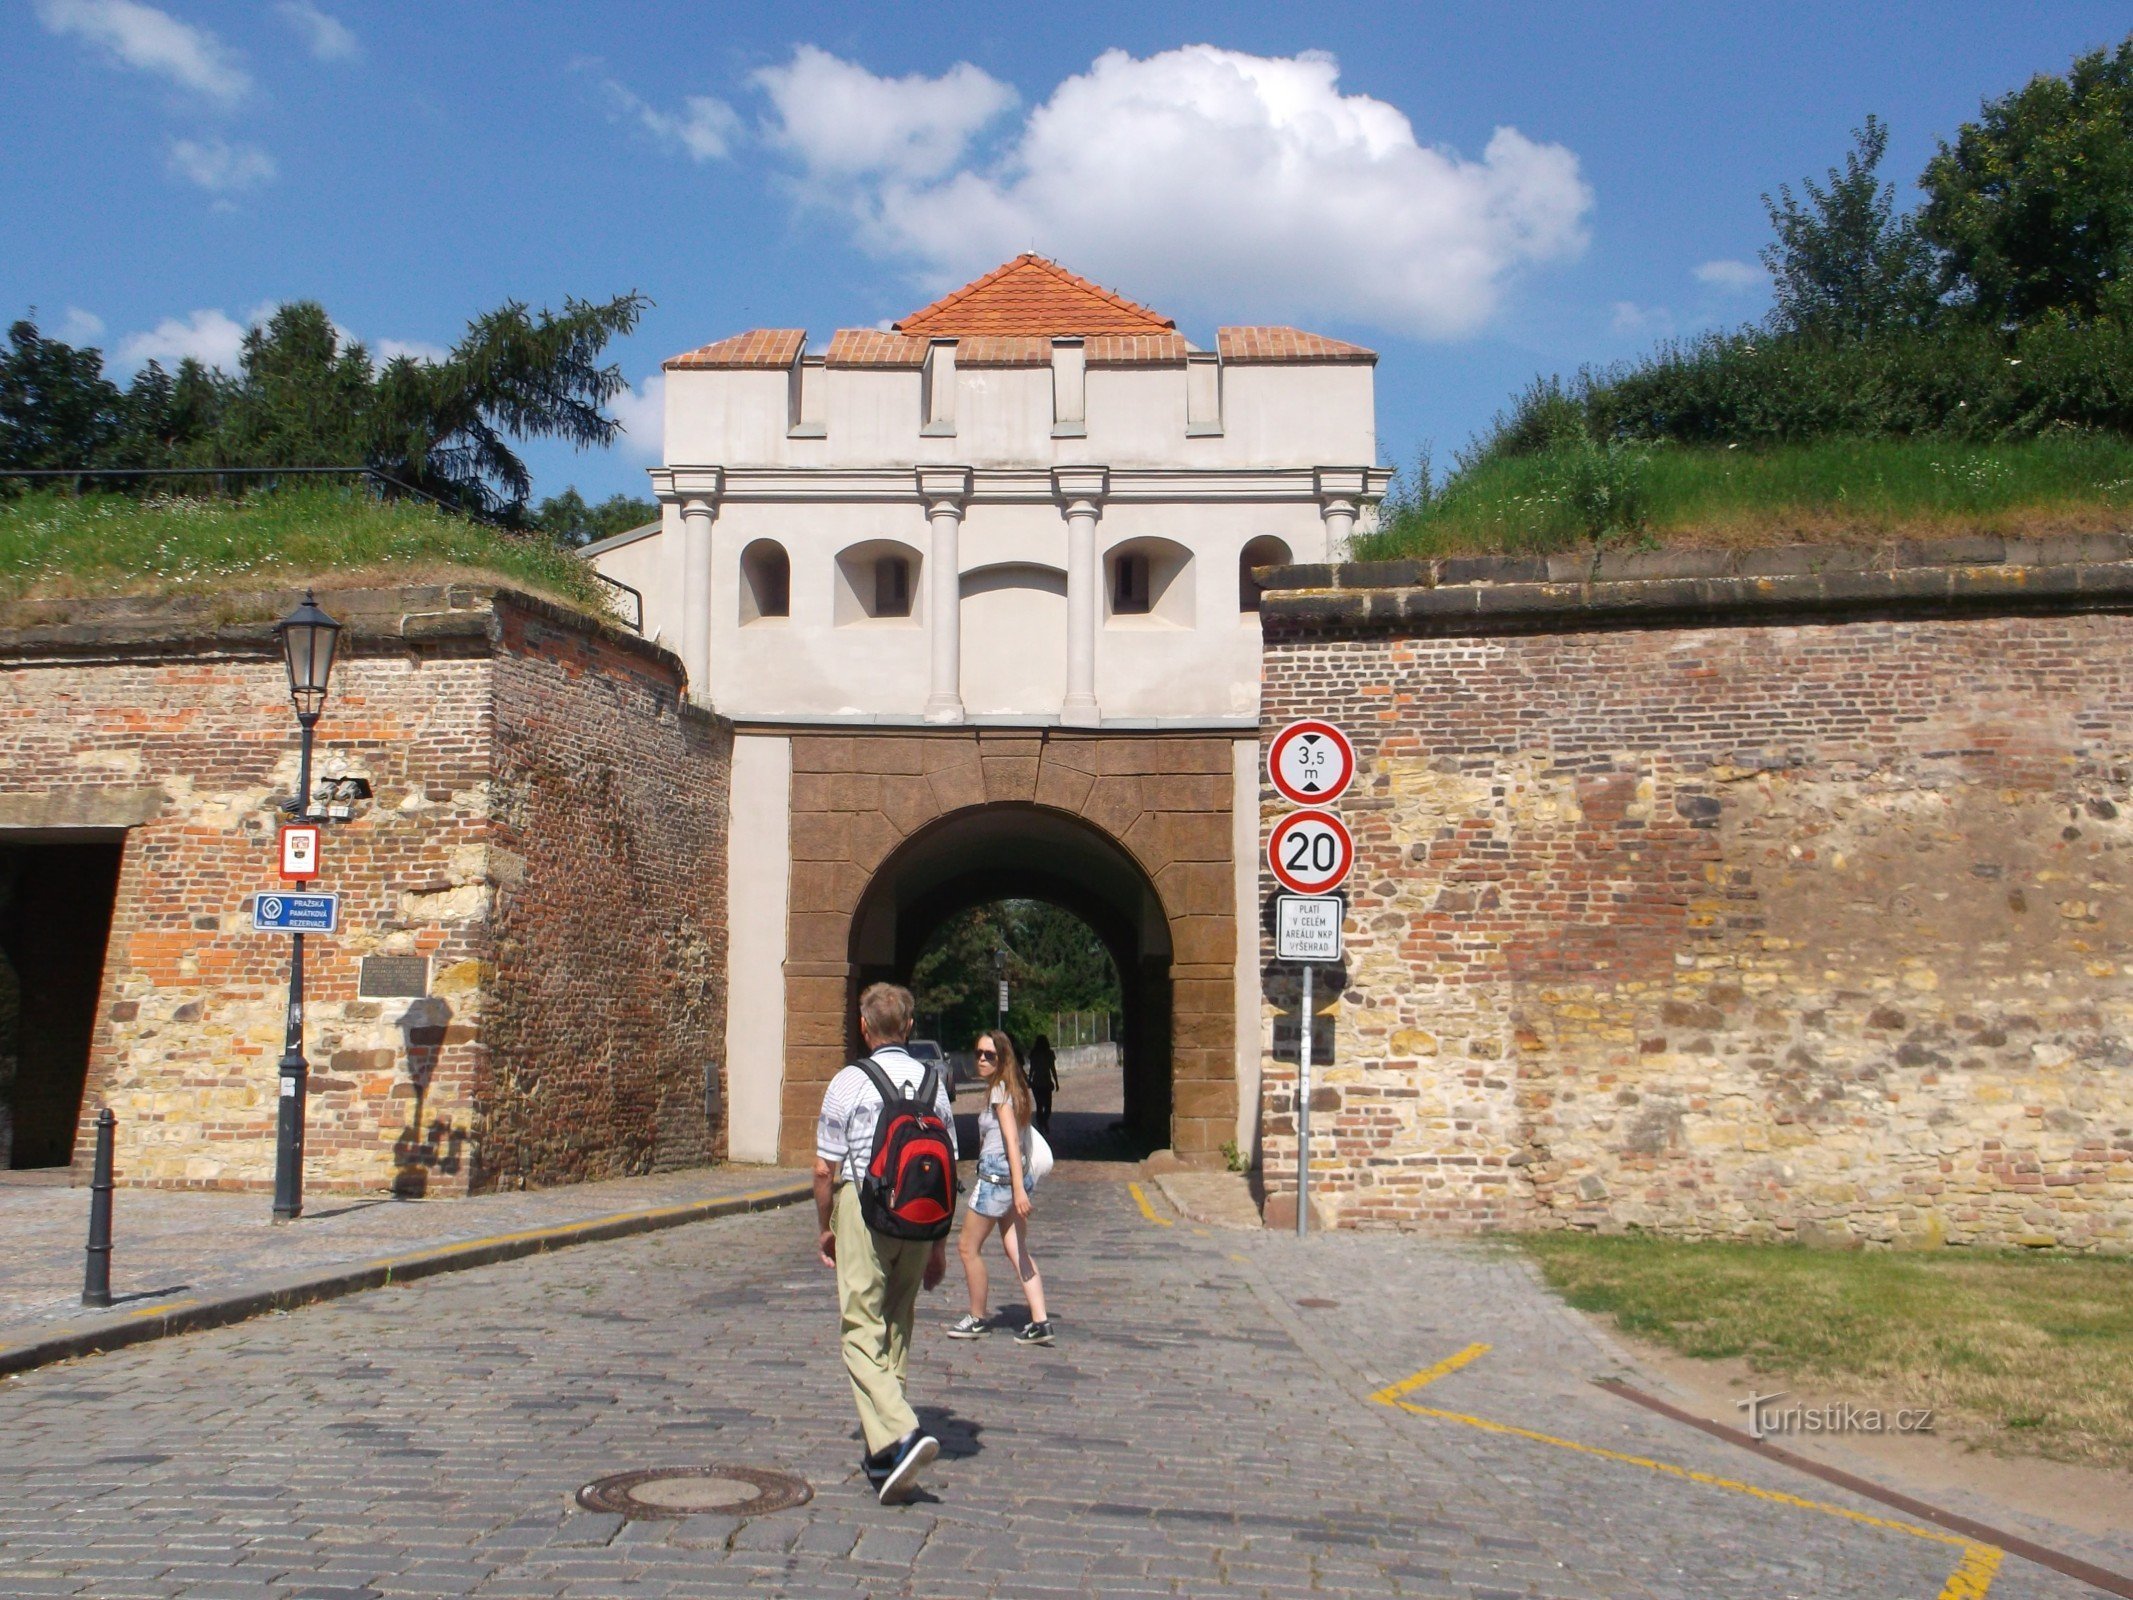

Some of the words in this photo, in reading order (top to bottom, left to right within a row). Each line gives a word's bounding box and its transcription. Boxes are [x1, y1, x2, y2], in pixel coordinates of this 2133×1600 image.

[1298, 746, 1325, 766] 3,5
[1304, 769, 1318, 779] m
[1286, 831, 1335, 872] 20
[293, 899, 325, 908] PRAŽSKÁ
[1299, 903, 1320, 914] PLATÍ
[289, 909, 328, 918] PAMÁTKOVÁ
[288, 919, 327, 928] REZERVACE
[1292, 917, 1298, 926] V
[1301, 916, 1326, 926] CELÉM
[1285, 928, 1315, 939] AREÁLU
[1317, 930, 1333, 939] NKP
[1289, 940, 1329, 951] VYŠEHRAD
